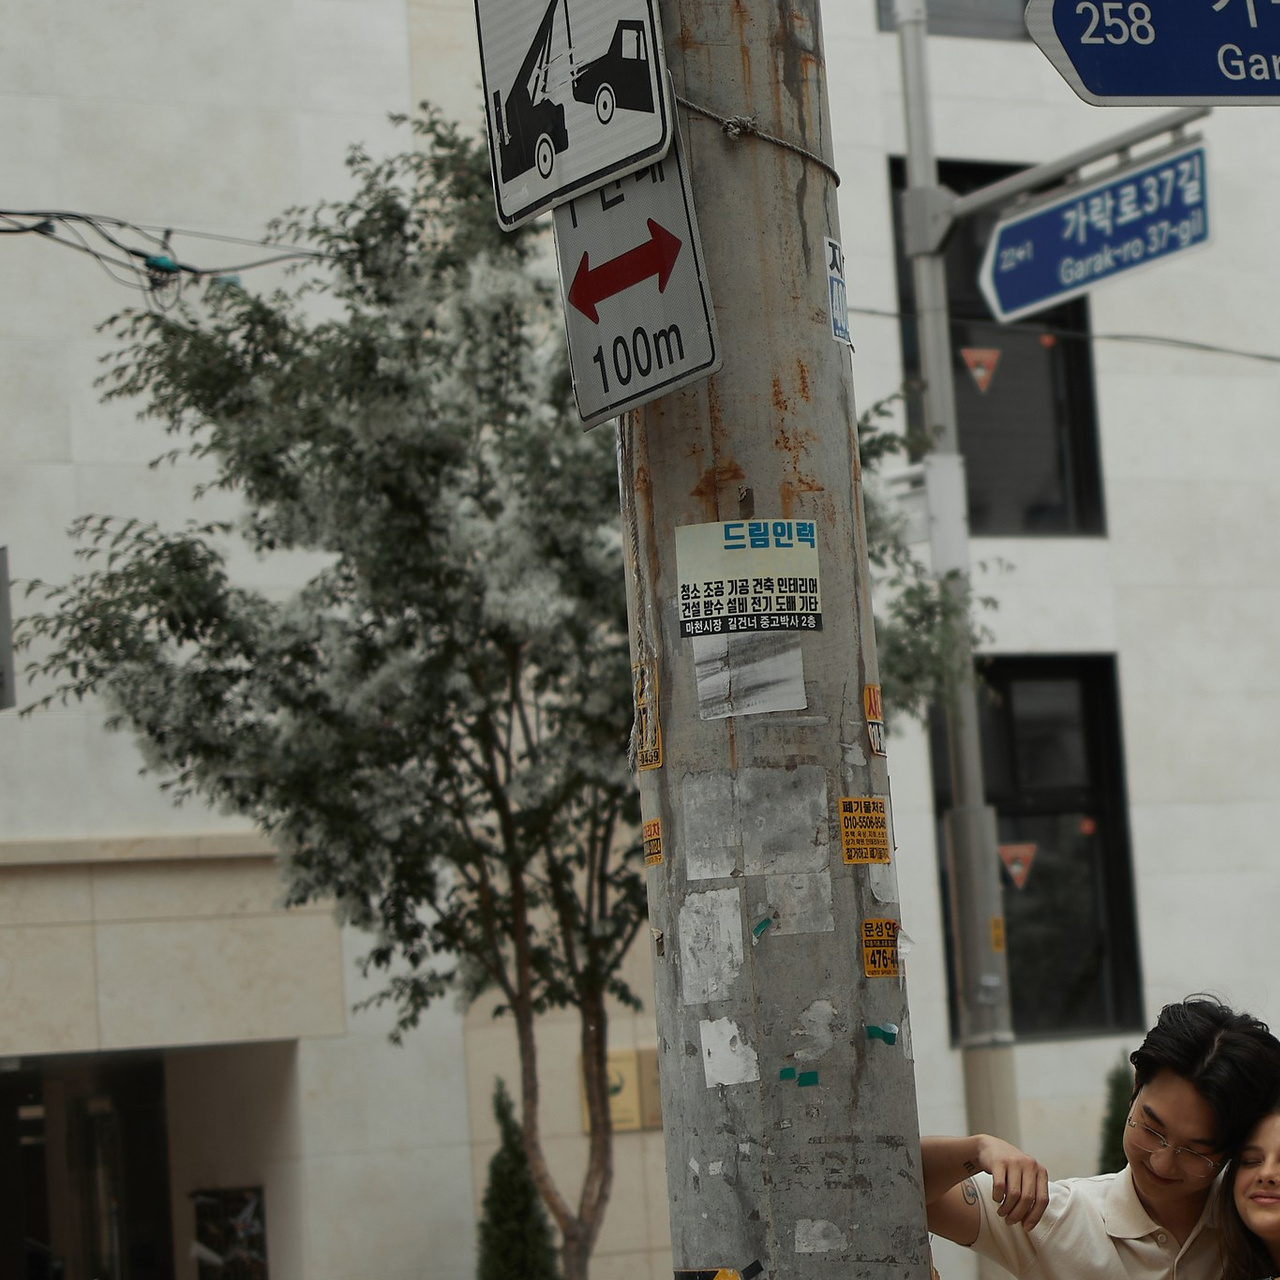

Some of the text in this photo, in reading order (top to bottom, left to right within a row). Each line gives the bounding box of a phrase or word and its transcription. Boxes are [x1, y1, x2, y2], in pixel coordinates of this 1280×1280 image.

[1075, 1, 1156, 46] 258
[1062, 155, 1200, 245] 가락로37길
[1058, 208, 1204, 286] Garak-ro 37-gil
[593, 324, 686, 396] 100m
[724, 522, 815, 550] 드림인력
[681, 577, 818, 601] 청소 조공 기공 건축 인테리어
[682, 596, 819, 619] 건설 방수 설비 전기 도배 기타
[685, 618, 722, 635] 마천시장
[728, 616, 757, 630] 길건너
[801, 615, 816, 628] 2층
[842, 801, 885, 813] 폐기물처리
